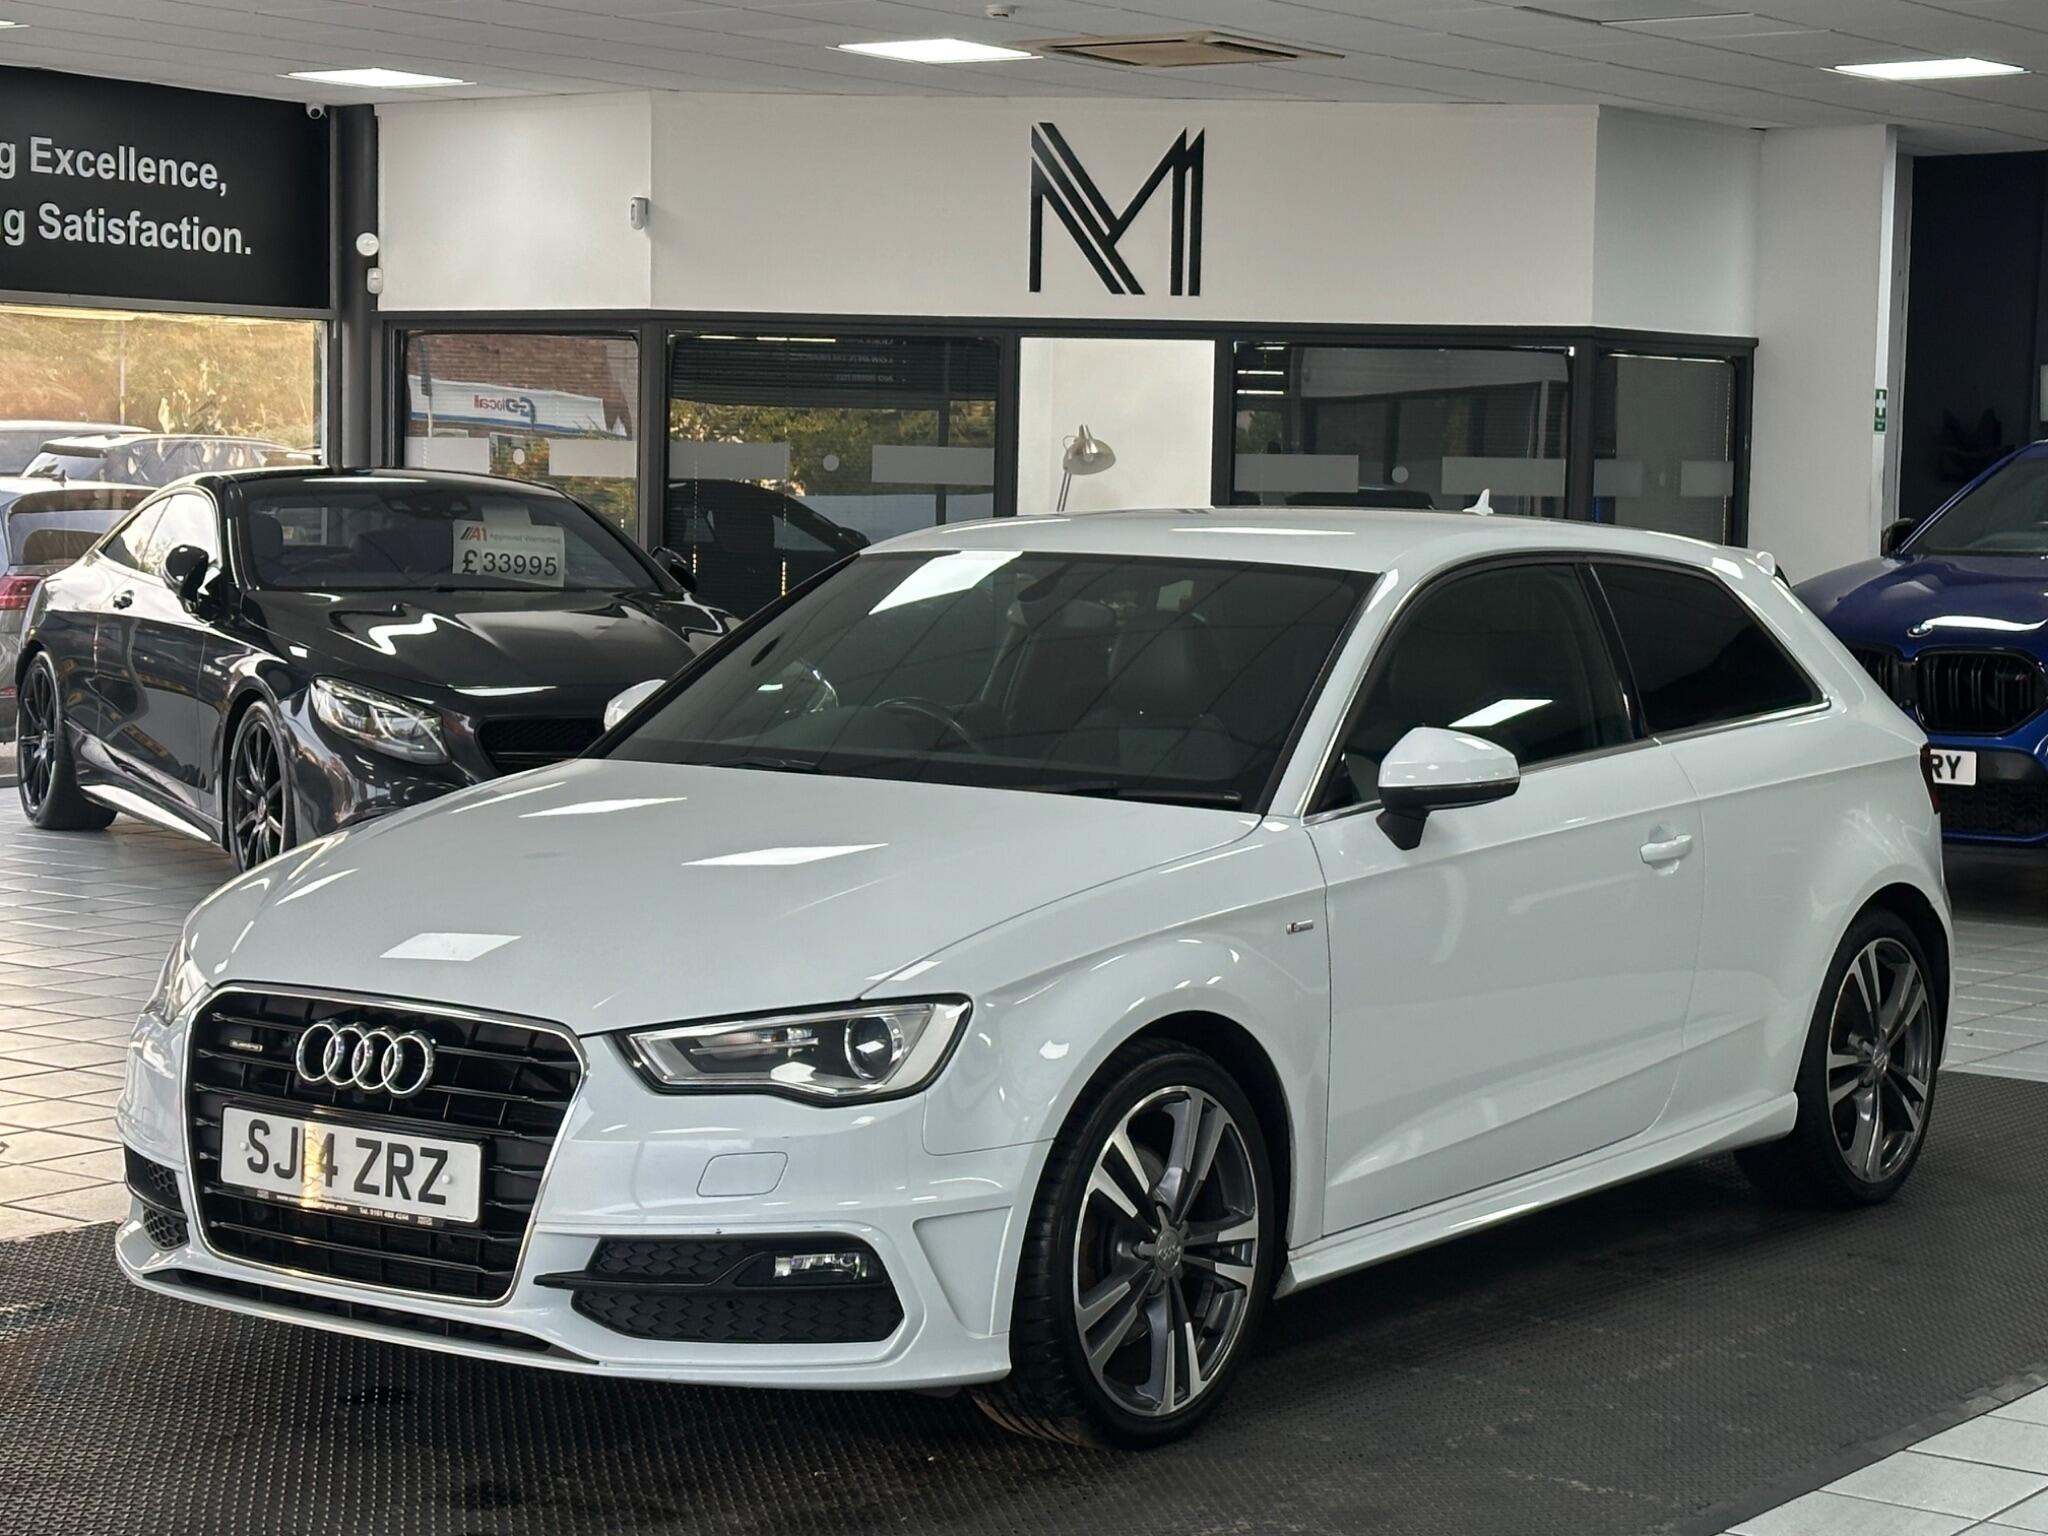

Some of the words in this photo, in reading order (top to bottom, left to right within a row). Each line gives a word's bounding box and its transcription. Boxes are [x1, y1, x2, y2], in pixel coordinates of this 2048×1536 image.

[30, 136, 227, 196] Excellence,
[38, 202, 251, 255] Satisfaction.
[462, 549, 557, 576] £33995
[354, 1136, 449, 1206] ZRZ
